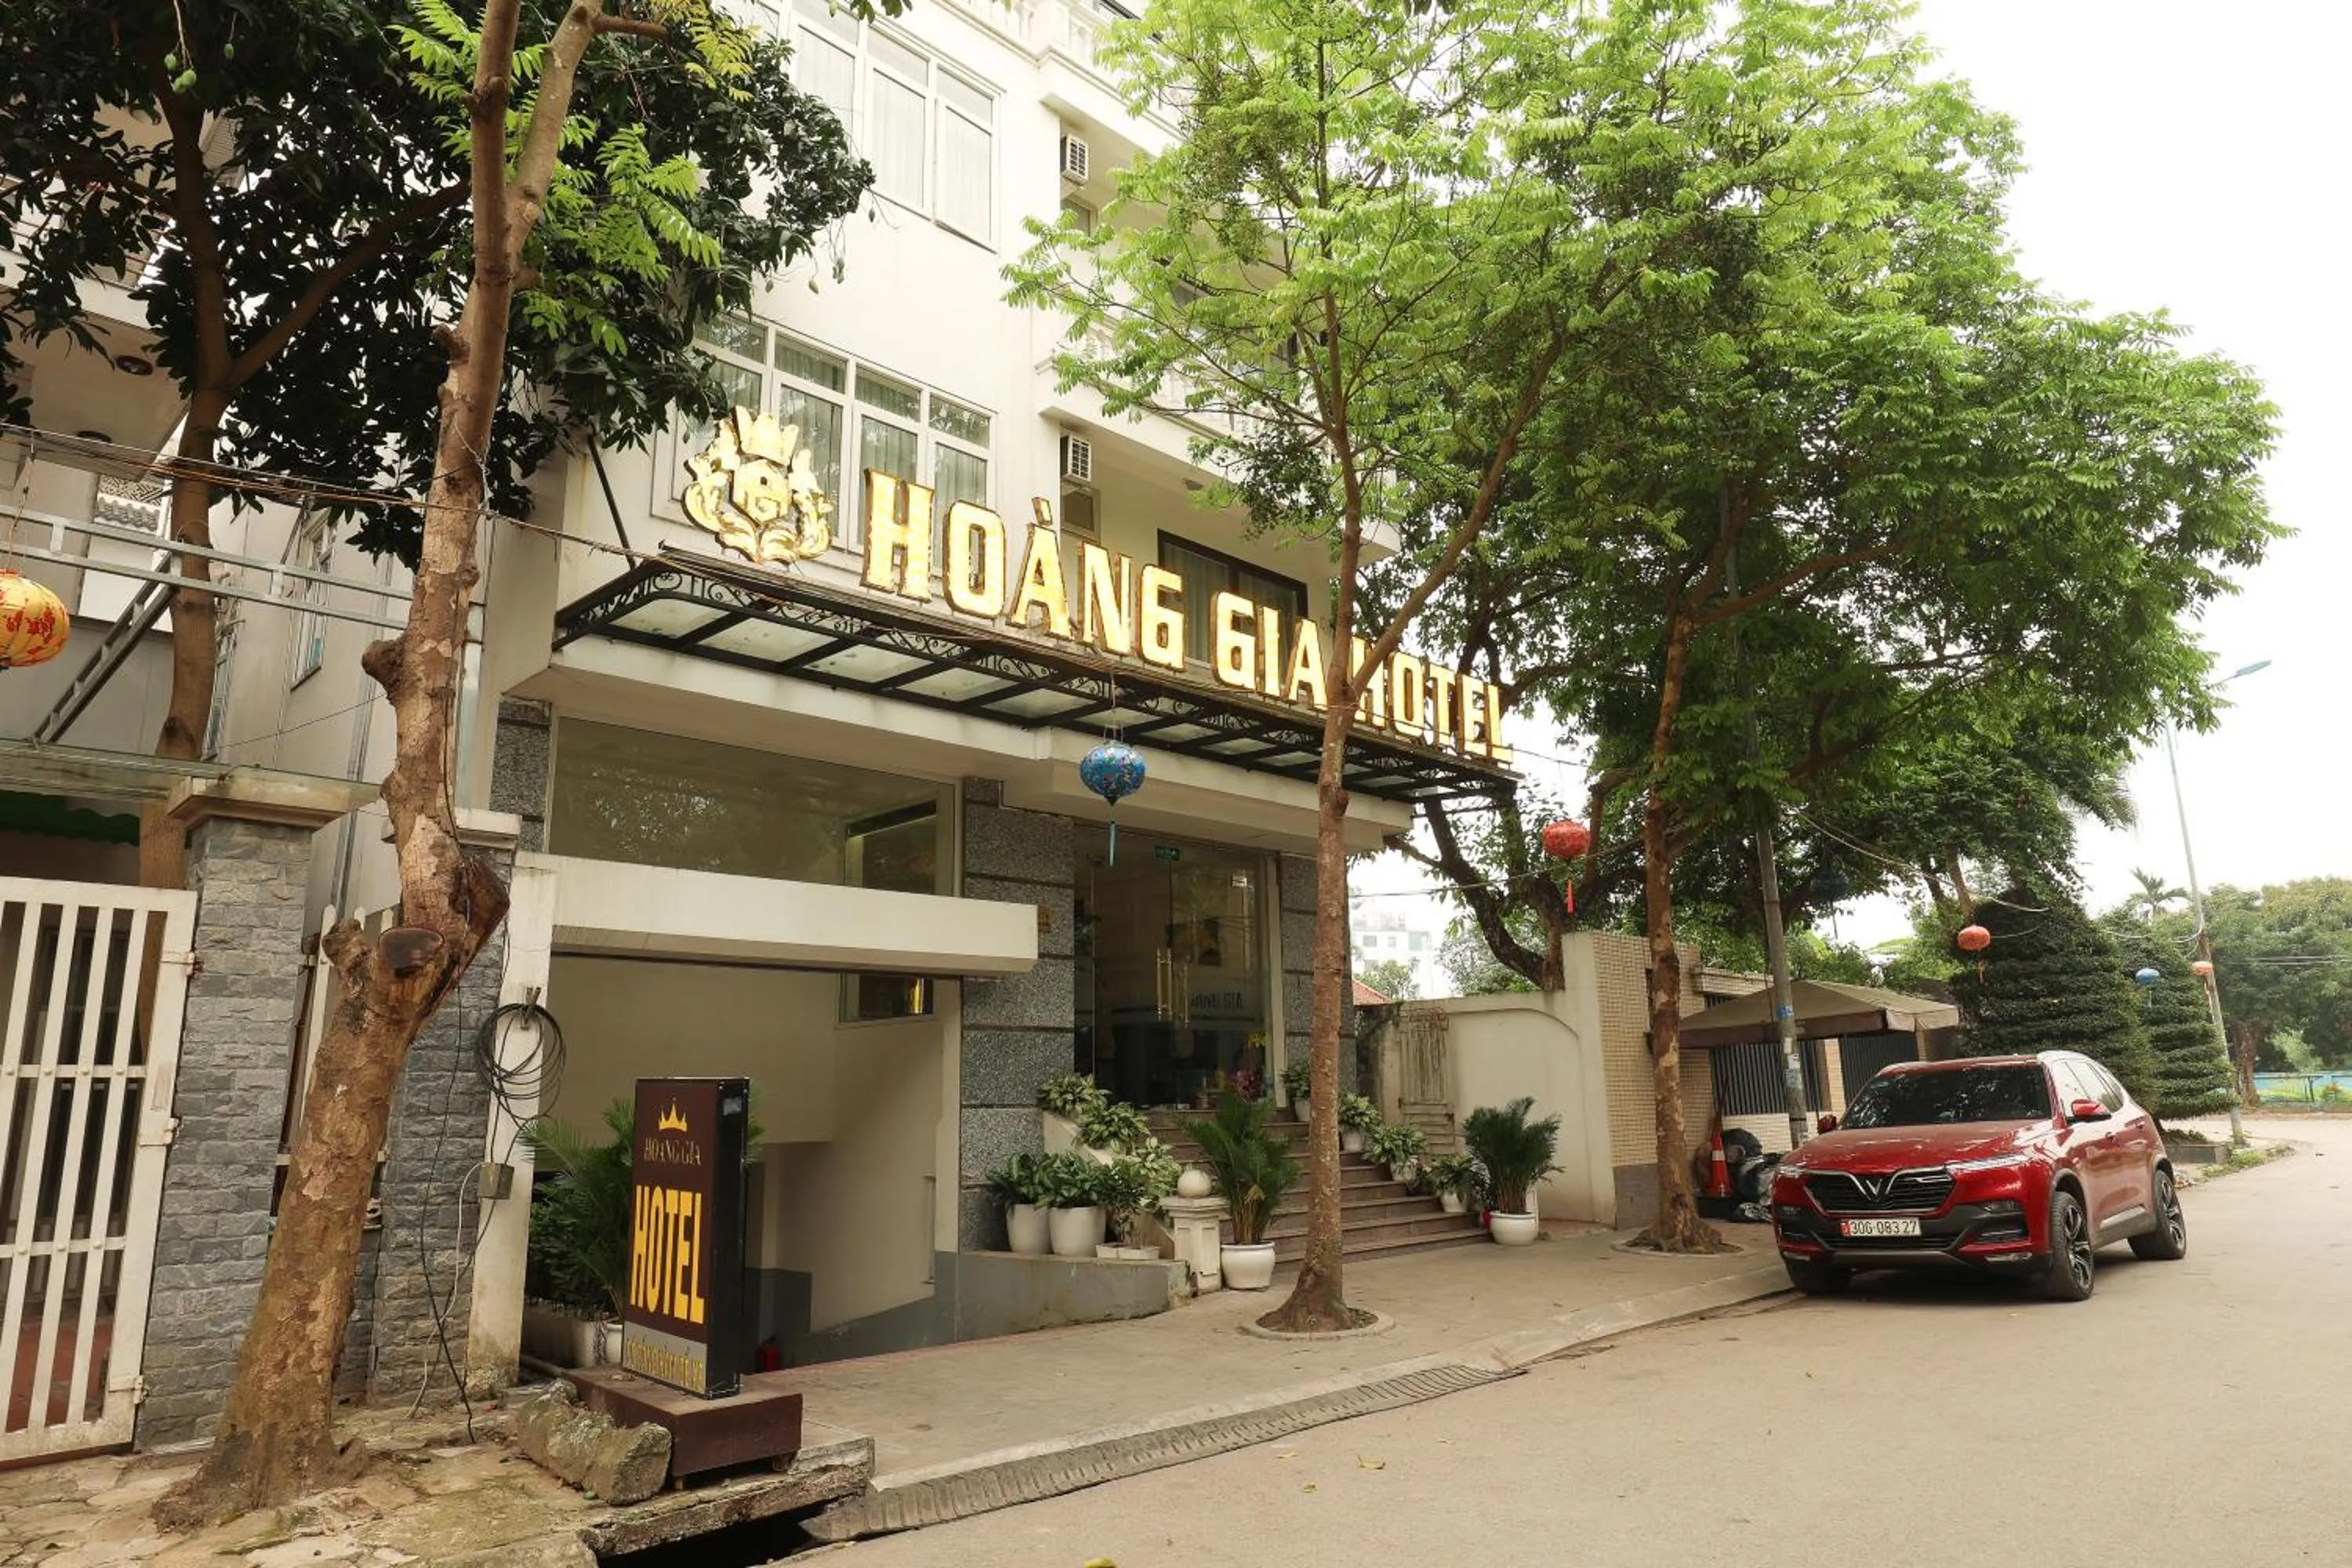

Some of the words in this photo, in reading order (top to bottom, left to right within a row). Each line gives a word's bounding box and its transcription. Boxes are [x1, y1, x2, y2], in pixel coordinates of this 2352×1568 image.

[862, 468, 1185, 673] HOÀNG
[1210, 590, 1329, 712] GIA
[681, 1140, 702, 1167] GIA
[630, 1185, 705, 1325] HOTEL
